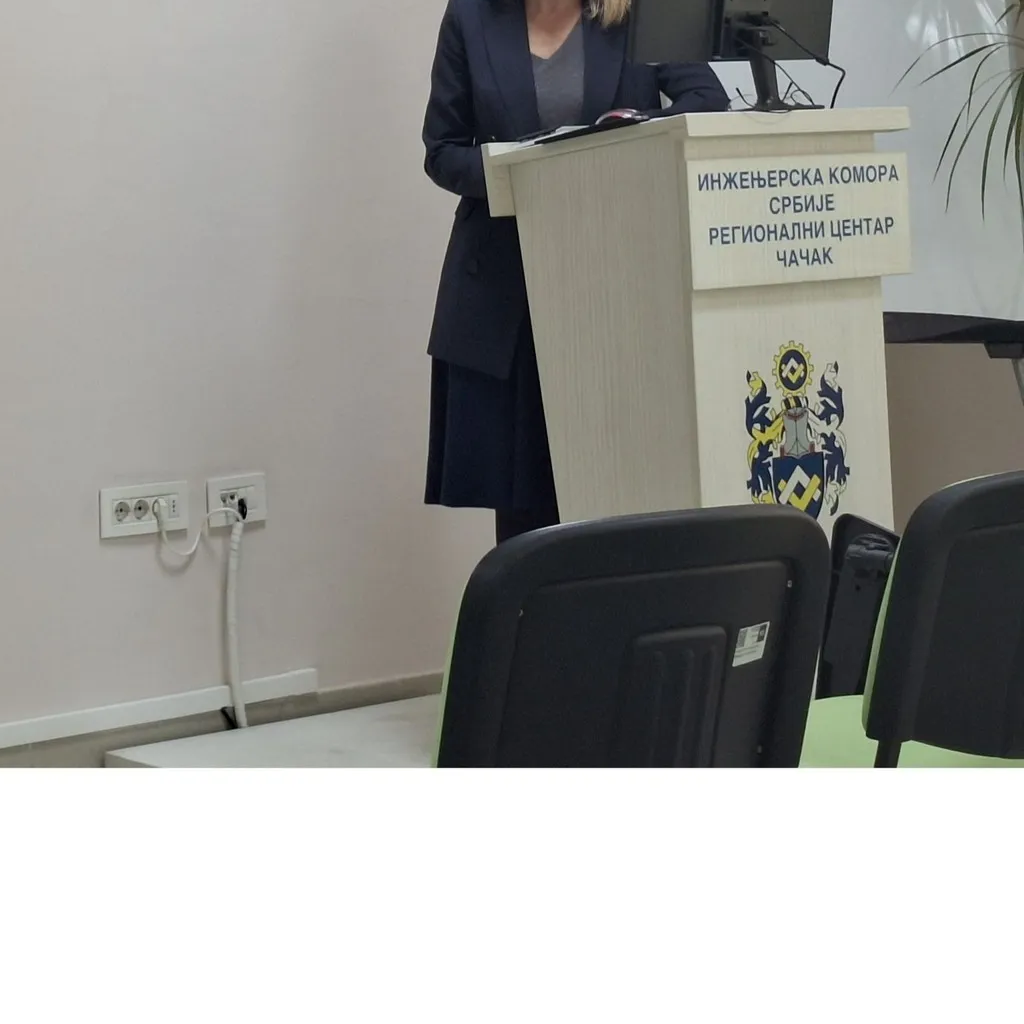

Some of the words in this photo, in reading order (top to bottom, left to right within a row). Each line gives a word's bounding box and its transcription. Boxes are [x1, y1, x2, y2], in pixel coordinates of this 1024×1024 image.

[697, 167, 824, 192] ИНЖЕЊЕРСКА
[828, 163, 900, 185] КОМОРА
[769, 193, 835, 215] СРБИЈЕ
[708, 221, 825, 246] РЕГИОНАЛНИ
[830, 216, 895, 242] ЦЕНТАР
[776, 247, 834, 268] ЧАЧАК
